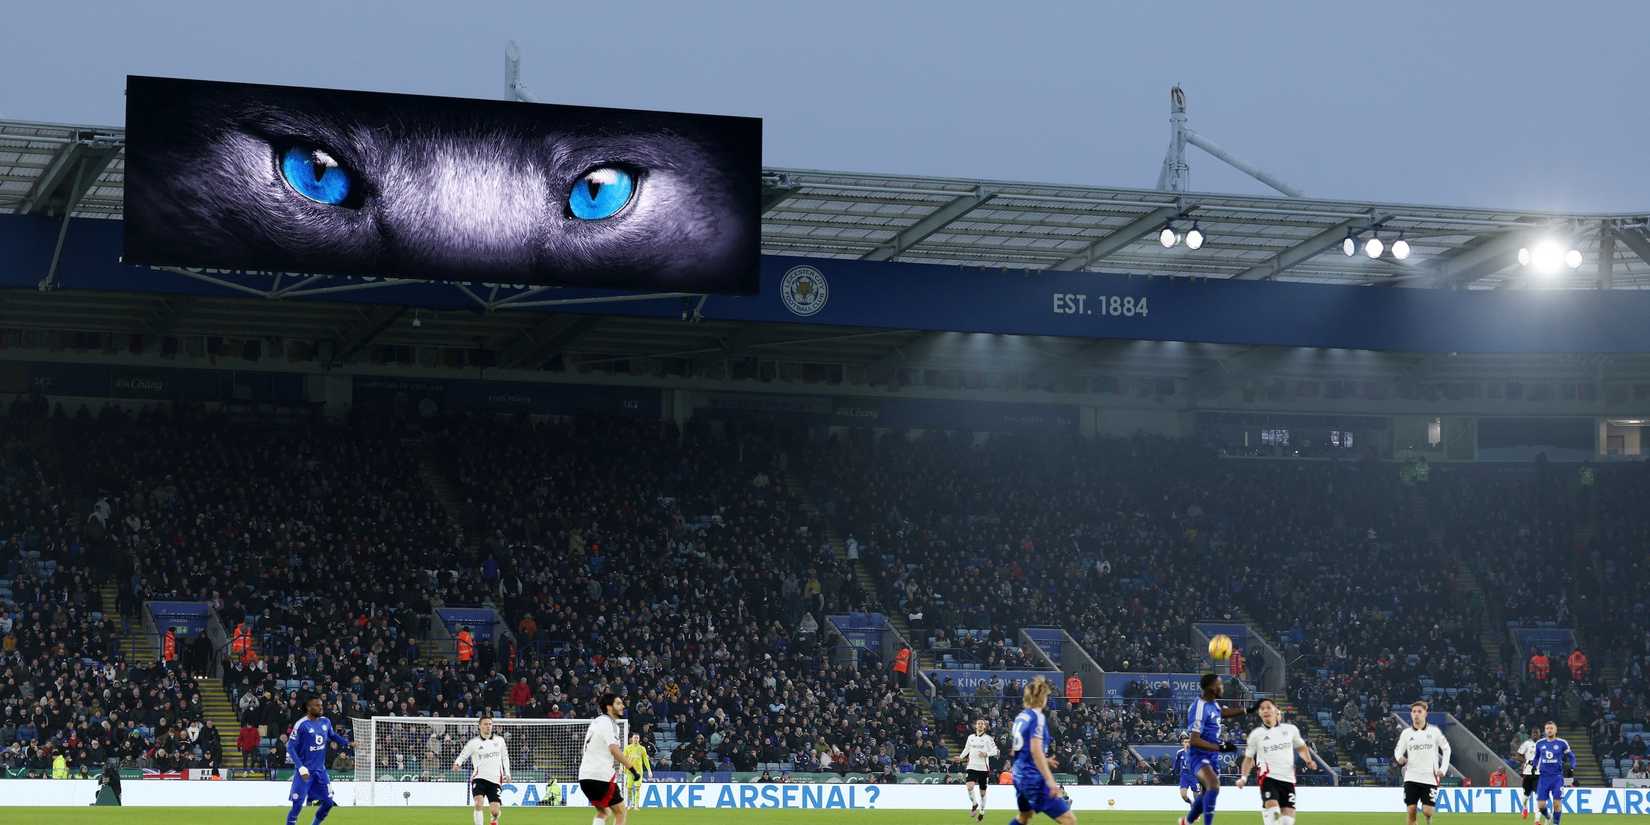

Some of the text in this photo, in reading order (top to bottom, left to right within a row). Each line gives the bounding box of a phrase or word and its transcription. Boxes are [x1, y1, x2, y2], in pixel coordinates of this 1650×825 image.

[1053, 293, 1149, 317] EST. 1884
[643, 784, 706, 809] AKE
[716, 785, 881, 809] ARSENAL?
[1435, 789, 1501, 814] AN'T
[1511, 789, 1591, 815] MKE
[1602, 789, 1650, 816] AR
